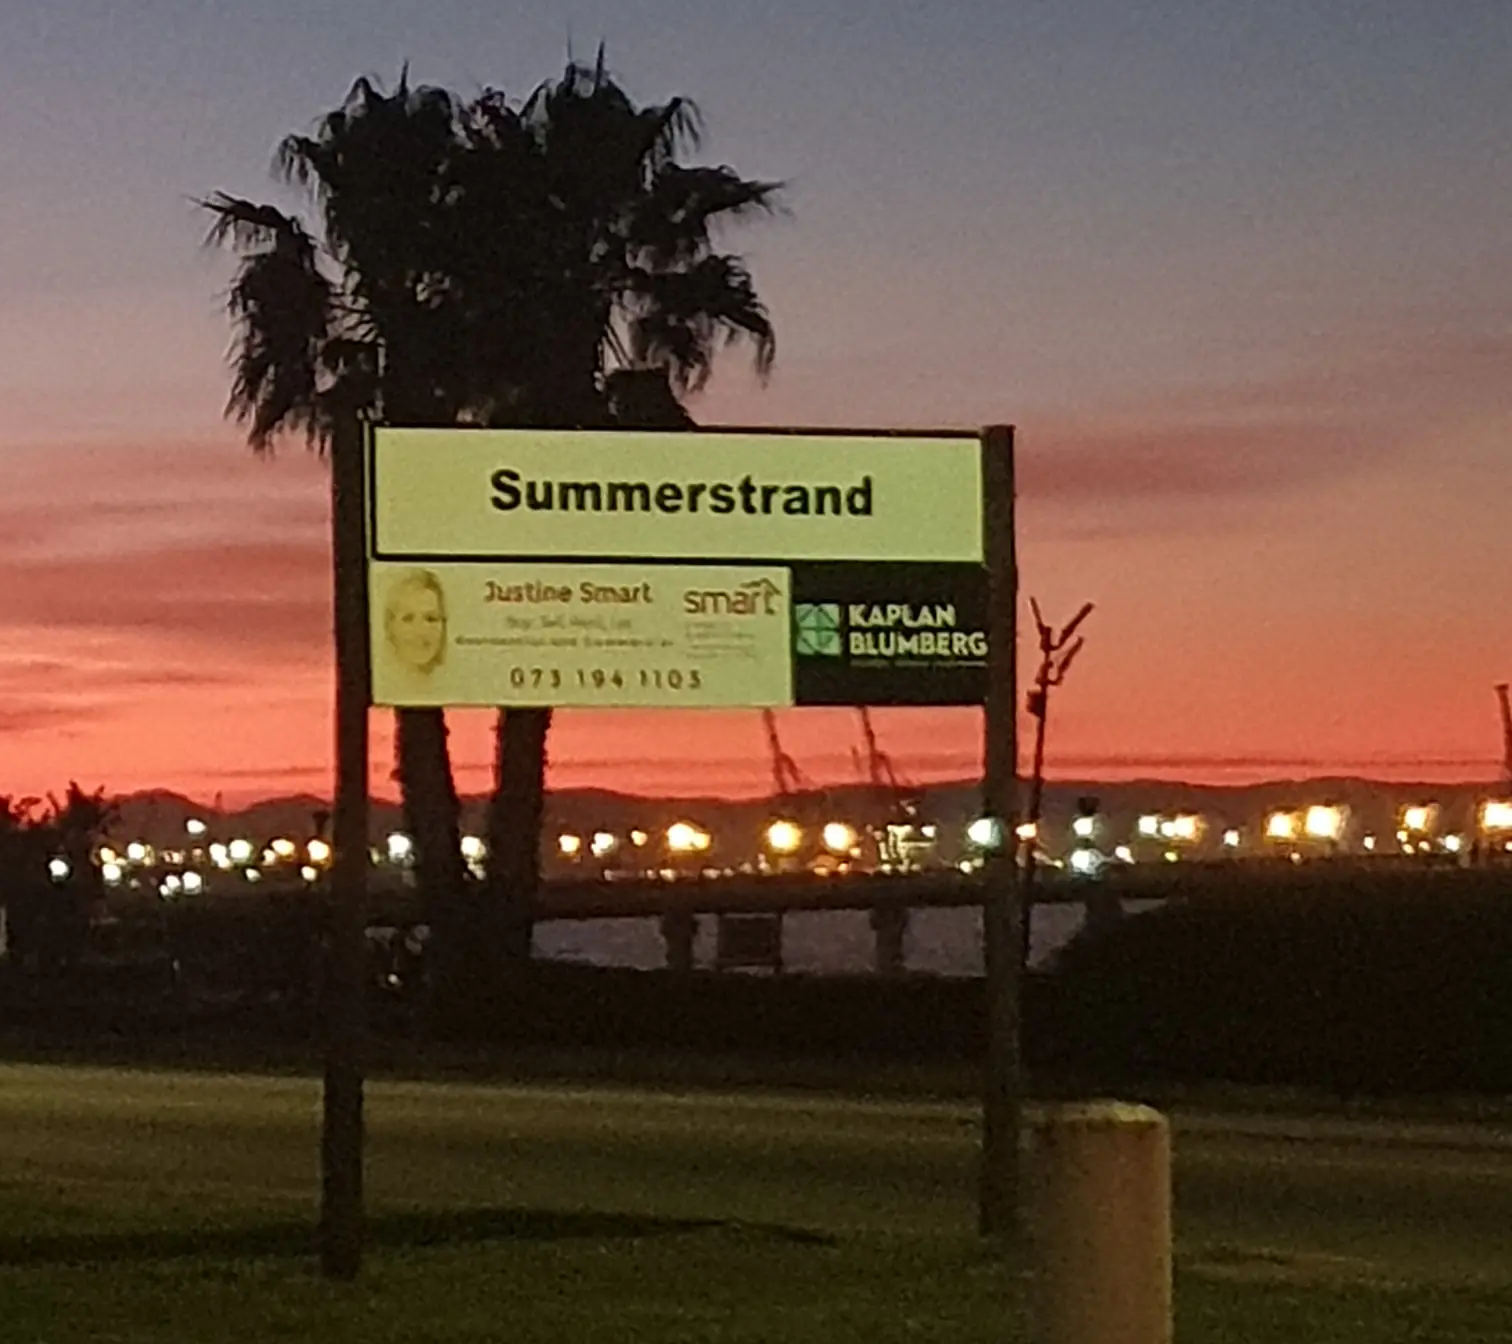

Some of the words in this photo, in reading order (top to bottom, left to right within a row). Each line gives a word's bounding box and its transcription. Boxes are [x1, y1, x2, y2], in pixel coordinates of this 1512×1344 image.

[490, 469, 873, 516] Summerstrand
[484, 580, 573, 603] Justine
[580, 581, 653, 603] Smart
[683, 585, 775, 616] smart
[849, 603, 956, 629] KAPLAN
[849, 631, 988, 656] BLUMBERG
